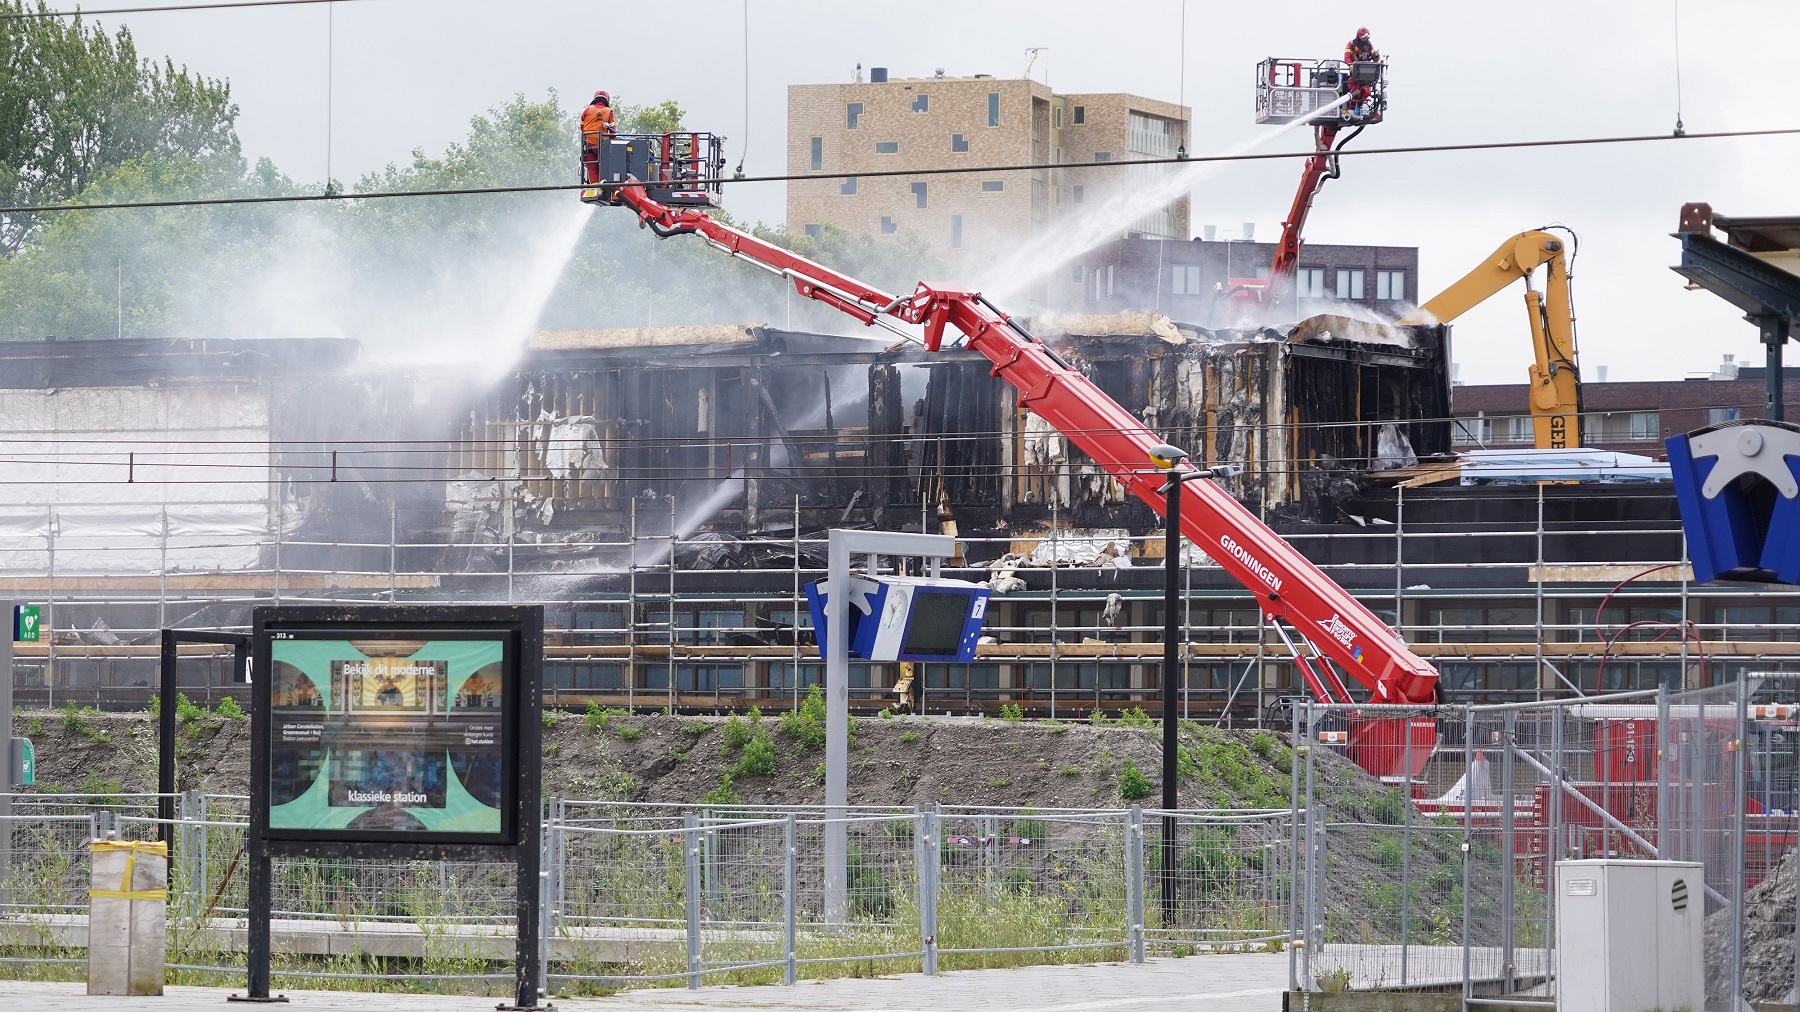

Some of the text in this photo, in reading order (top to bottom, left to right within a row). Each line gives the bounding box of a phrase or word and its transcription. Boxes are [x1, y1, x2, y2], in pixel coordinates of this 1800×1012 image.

[1220, 534, 1283, 591] GRONINGEN
[976, 604, 981, 616] 7
[1334, 618, 1356, 638] BRONTO
[343, 664, 435, 677] Bekijk dit moderne
[348, 790, 427, 802] klassieke station
